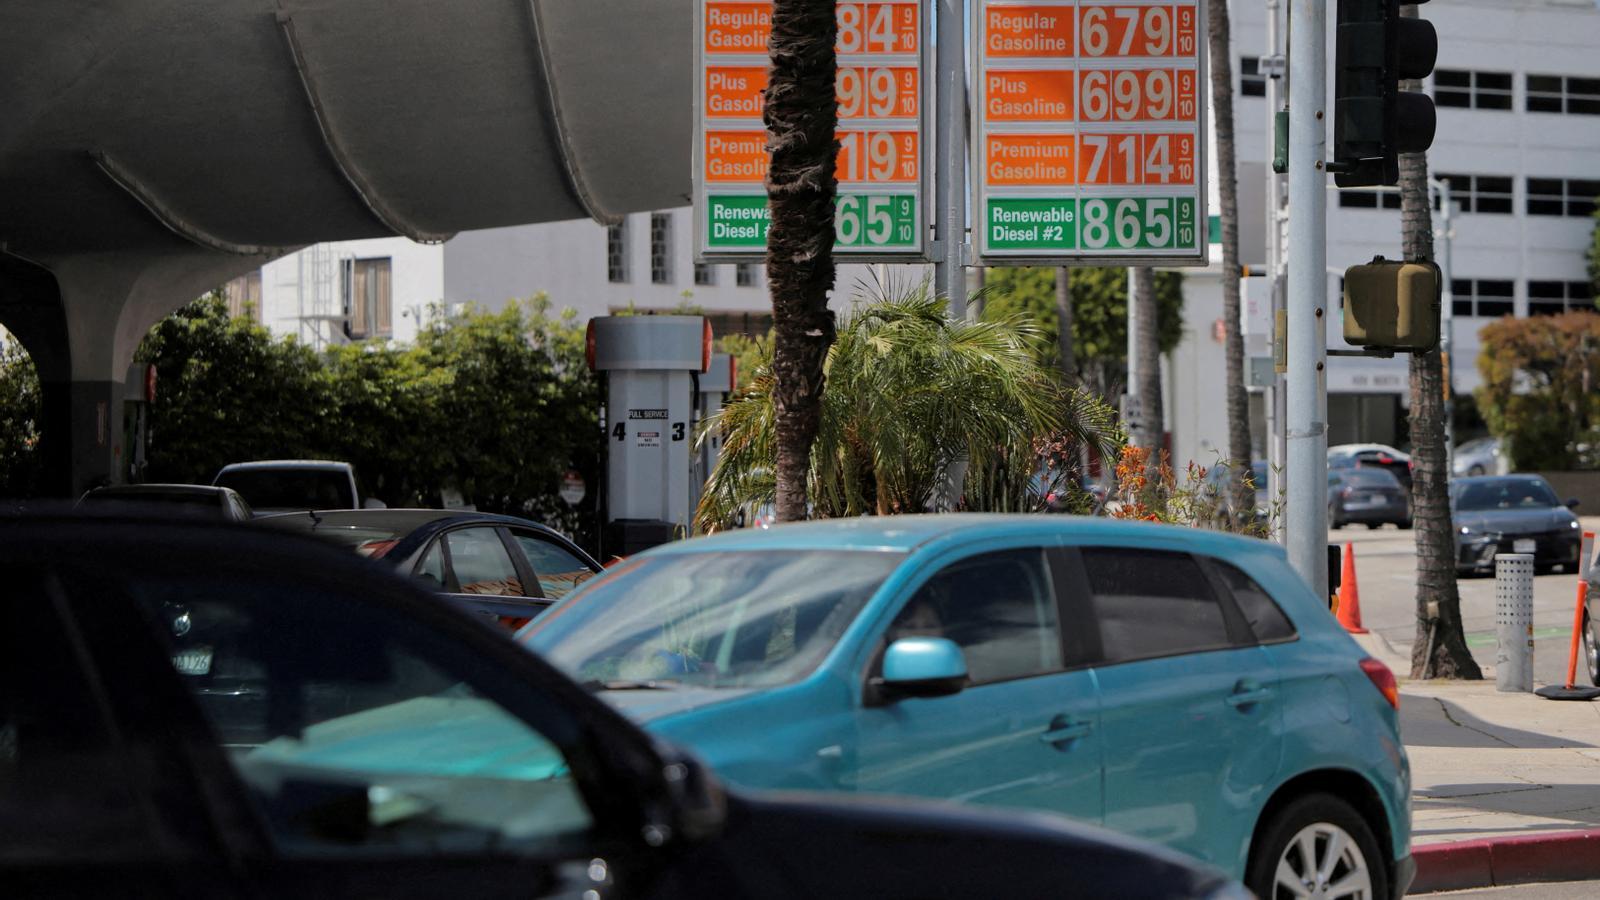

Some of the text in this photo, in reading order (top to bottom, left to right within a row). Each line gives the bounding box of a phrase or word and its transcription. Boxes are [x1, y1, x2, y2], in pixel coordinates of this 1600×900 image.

[709, 8, 771, 29] Regula
[903, 8, 913, 24] 9
[990, 12, 1057, 33] Regular
[1181, 11, 1190, 27] 9
[836, 5, 898, 52] 84
[1081, 6, 1171, 56] 679
[709, 29, 769, 48] Gasoli
[901, 32, 915, 49] 10
[990, 33, 1067, 51] Gasoline
[1180, 36, 1193, 52] 10
[709, 73, 747, 90] Plus
[904, 72, 913, 88] 9
[990, 77, 1028, 93] Plus
[1181, 74, 1191, 91] 9
[834, 68, 897, 117] 99
[1081, 69, 1172, 120] 699
[709, 94, 764, 112] Gasoli
[901, 96, 915, 113] 10
[990, 97, 1066, 115] Gasoline
[1180, 100, 1193, 116] 10
[709, 137, 767, 154] Premi
[904, 136, 913, 152] 9
[991, 140, 1070, 158] Premium
[1180, 138, 1190, 155] 9
[840, 131, 897, 180] 19
[1082, 135, 1174, 184] 714
[709, 158, 769, 176] Gasoli
[901, 161, 915, 177] 10
[990, 161, 1067, 179] Gasoline
[1178, 164, 1192, 180] 10
[714, 204, 772, 219] Renewa
[901, 199, 910, 216] 9
[993, 206, 1073, 223] Renewable
[1181, 202, 1190, 219] 9
[834, 195, 893, 244] 65
[1083, 198, 1172, 249] 865
[714, 222, 759, 238] Diesel
[899, 225, 912, 241] 10
[993, 226, 1063, 241] Diesel #2
[1179, 227, 1192, 243] 10
[629, 410, 668, 418] FULL SERVICE
[612, 422, 626, 441] 4
[672, 422, 685, 441] 3
